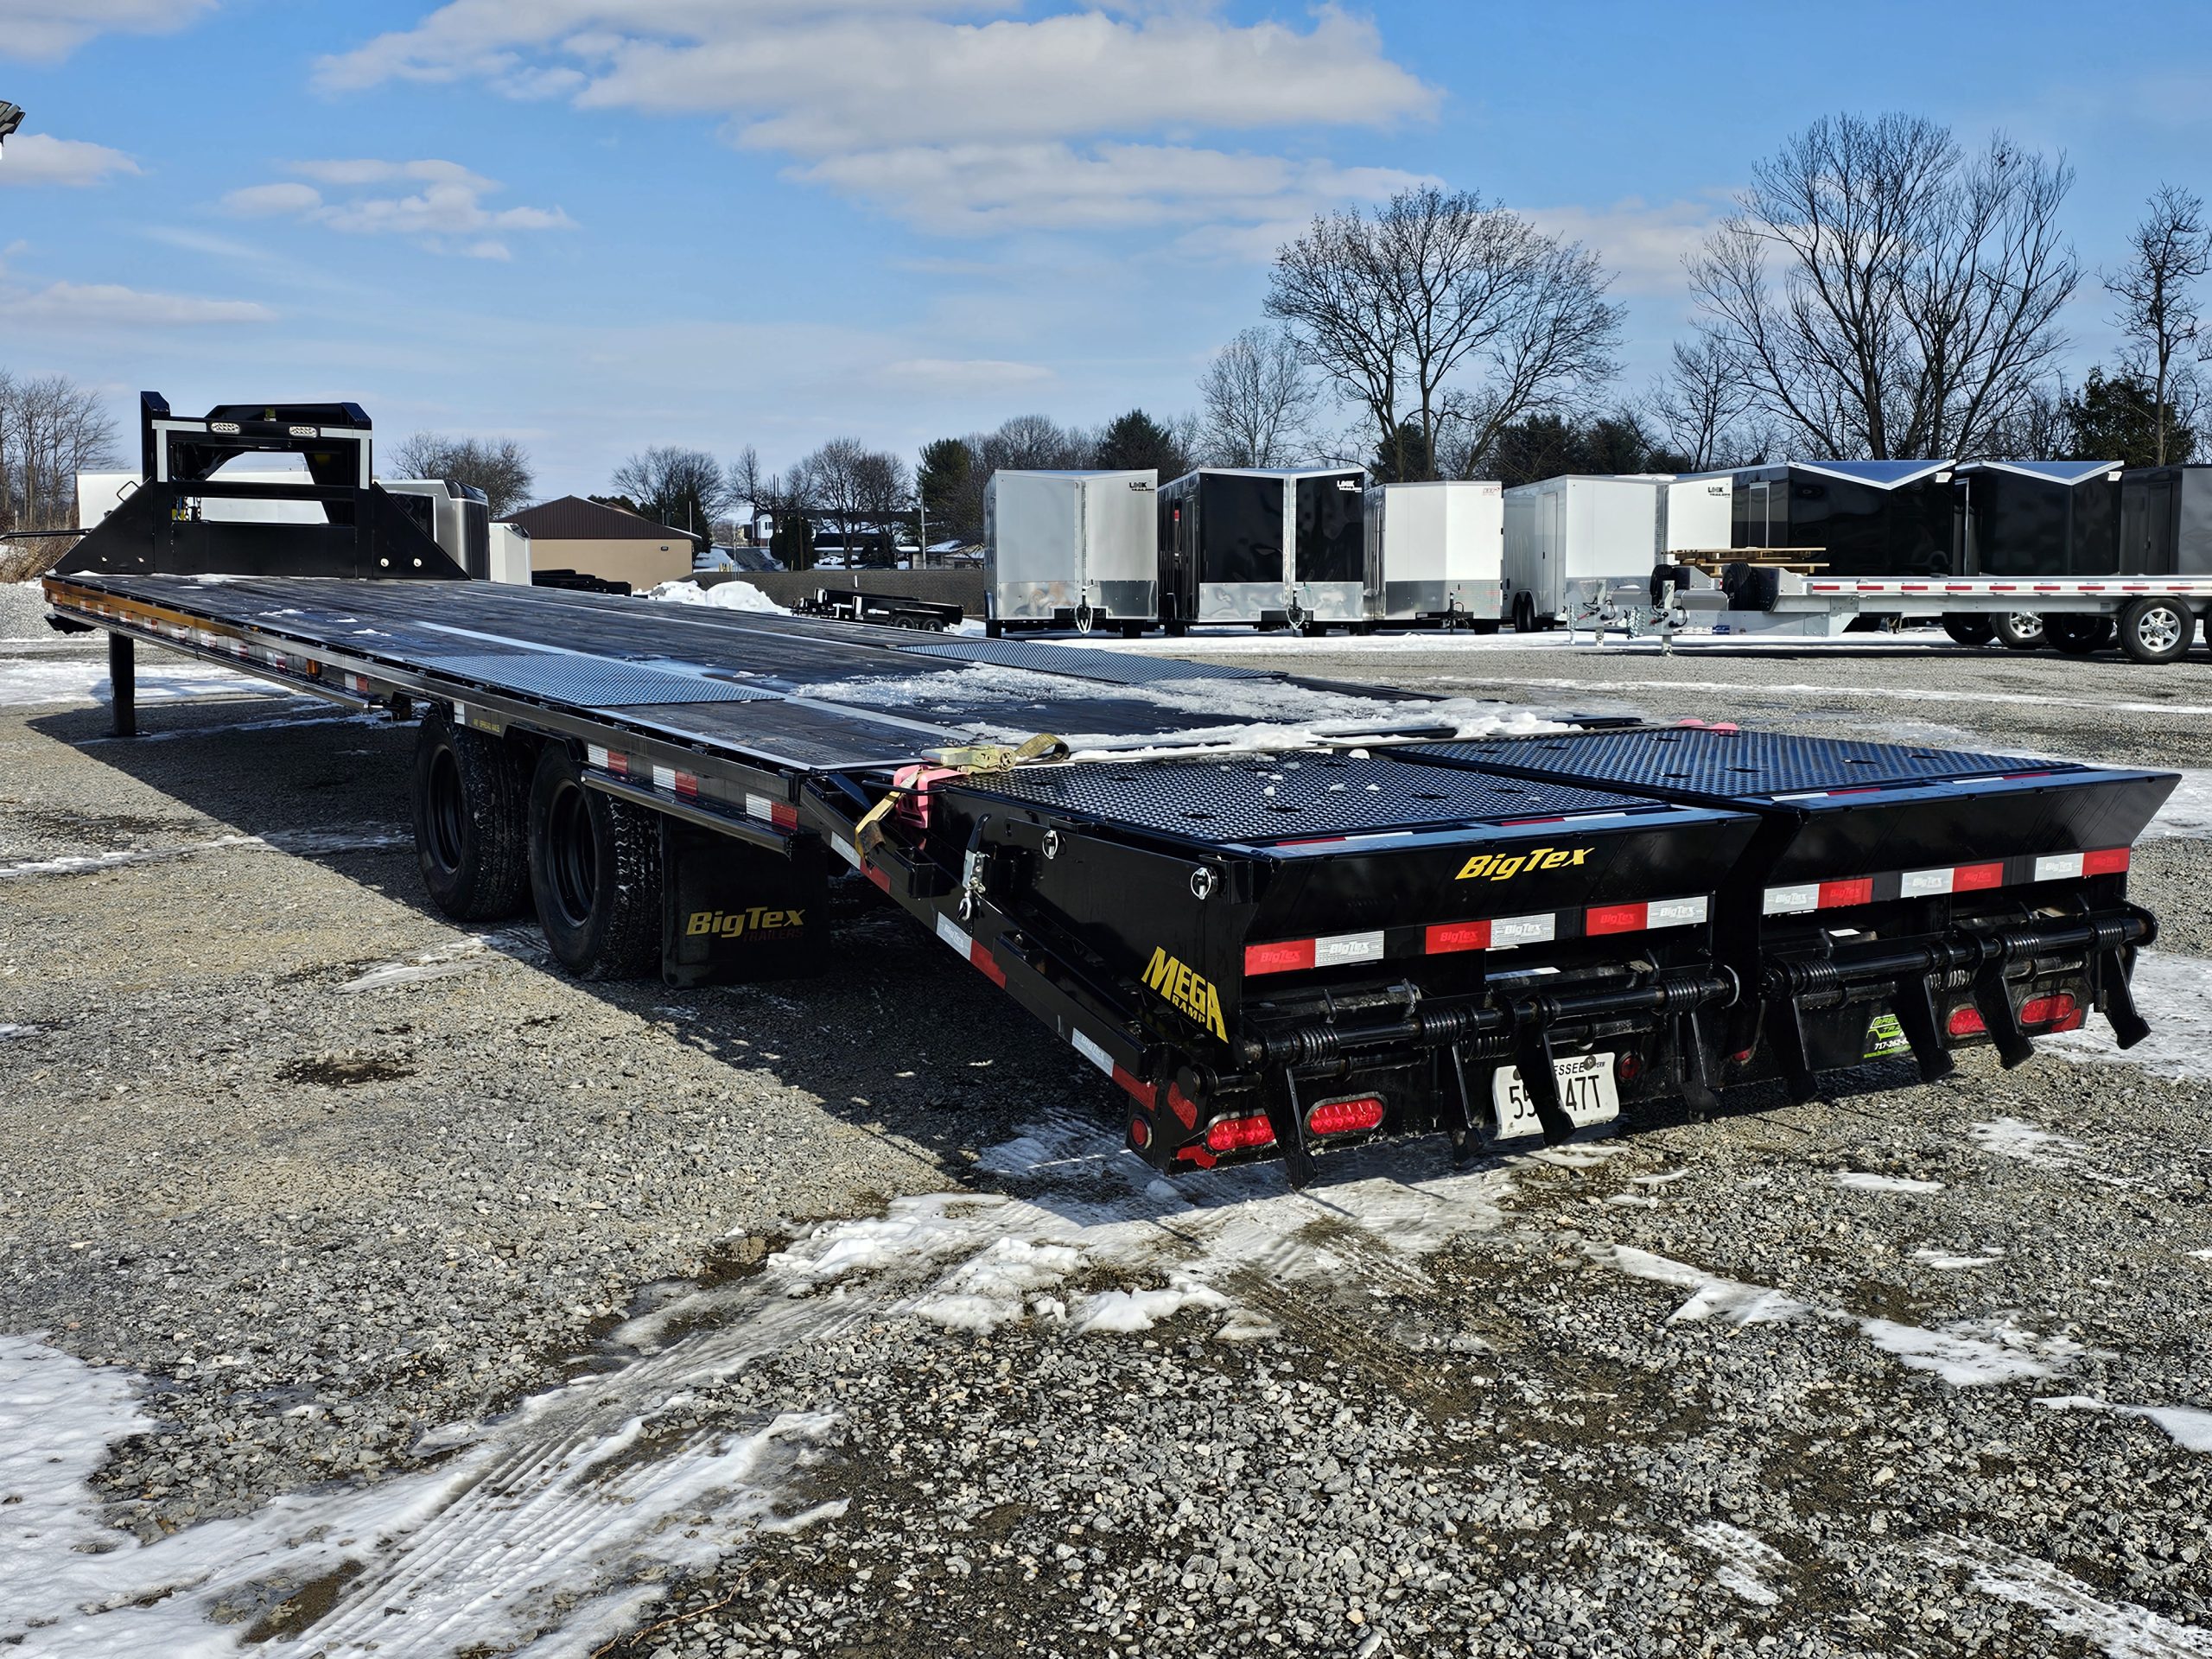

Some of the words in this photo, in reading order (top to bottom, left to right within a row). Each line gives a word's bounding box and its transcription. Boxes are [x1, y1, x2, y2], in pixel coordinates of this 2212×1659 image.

[1454, 848, 1596, 881] BigTex
[686, 906, 805, 938] BigTex
[1141, 945, 1229, 1044] MEGA
[1172, 995, 1205, 1023] RAMP
